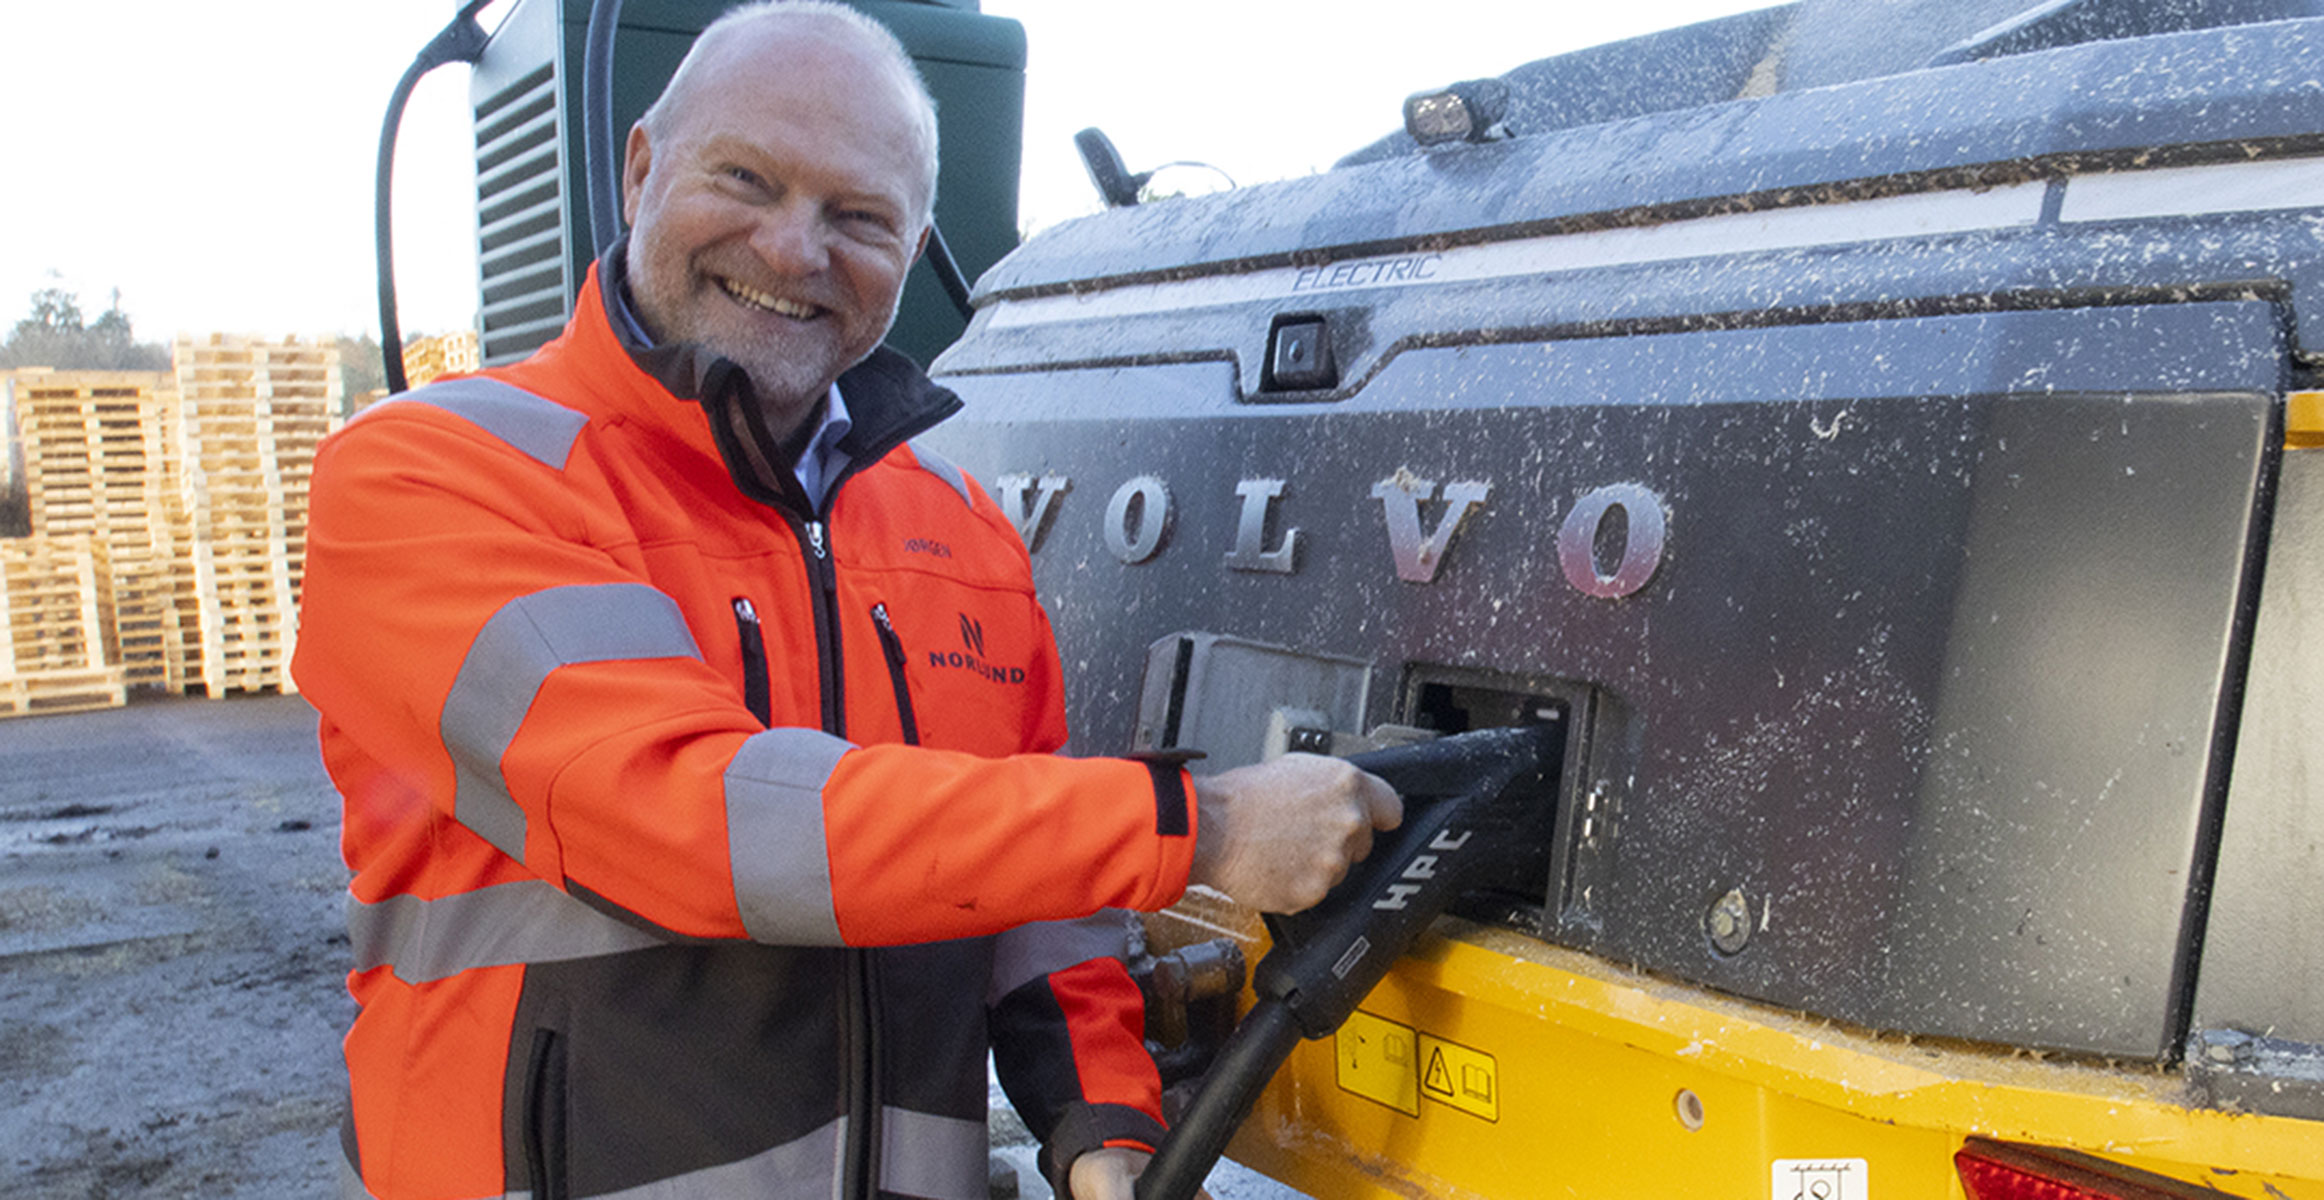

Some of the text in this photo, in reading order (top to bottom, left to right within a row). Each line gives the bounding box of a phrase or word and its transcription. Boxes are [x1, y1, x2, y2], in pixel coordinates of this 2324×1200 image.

[1293, 254, 1442, 291] ELECTRIC
[995, 475, 1667, 599] VOLVO
[1372, 829, 1472, 910] HPC
